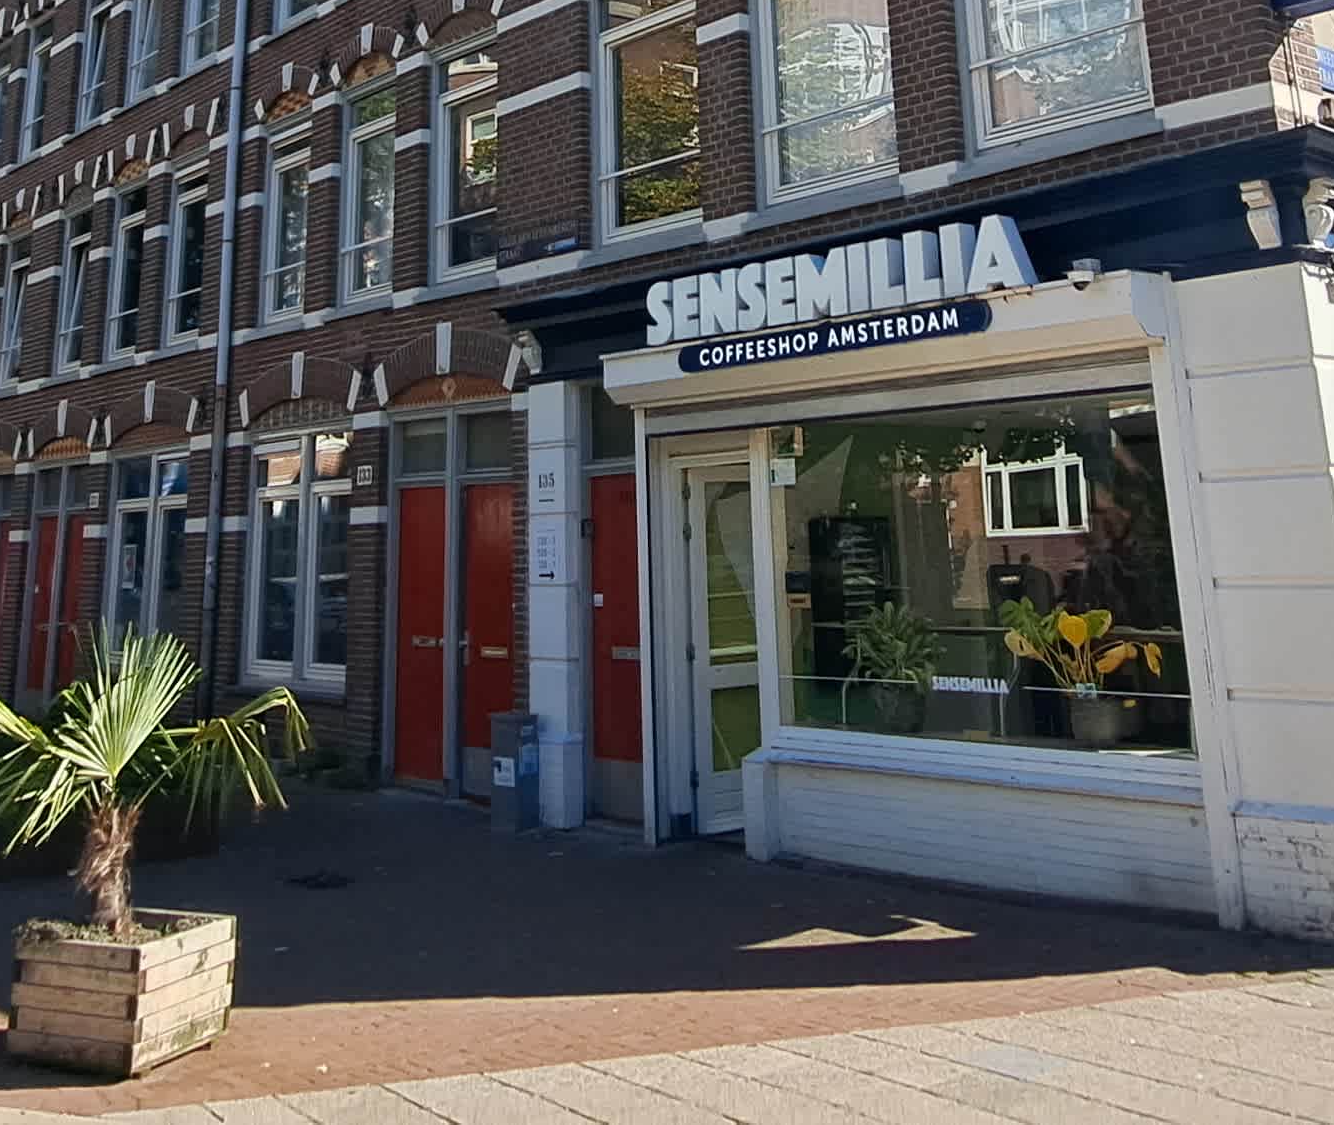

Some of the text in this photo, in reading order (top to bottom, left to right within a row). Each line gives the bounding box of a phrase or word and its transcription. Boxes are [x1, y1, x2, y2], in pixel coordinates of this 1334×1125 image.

[646, 214, 1038, 345] SENSEMILLIA
[699, 309, 959, 366] COFFEESHOP AMSTERDAM
[538, 473, 555, 489] 135
[932, 675, 1009, 694] SENSEMILLIA
